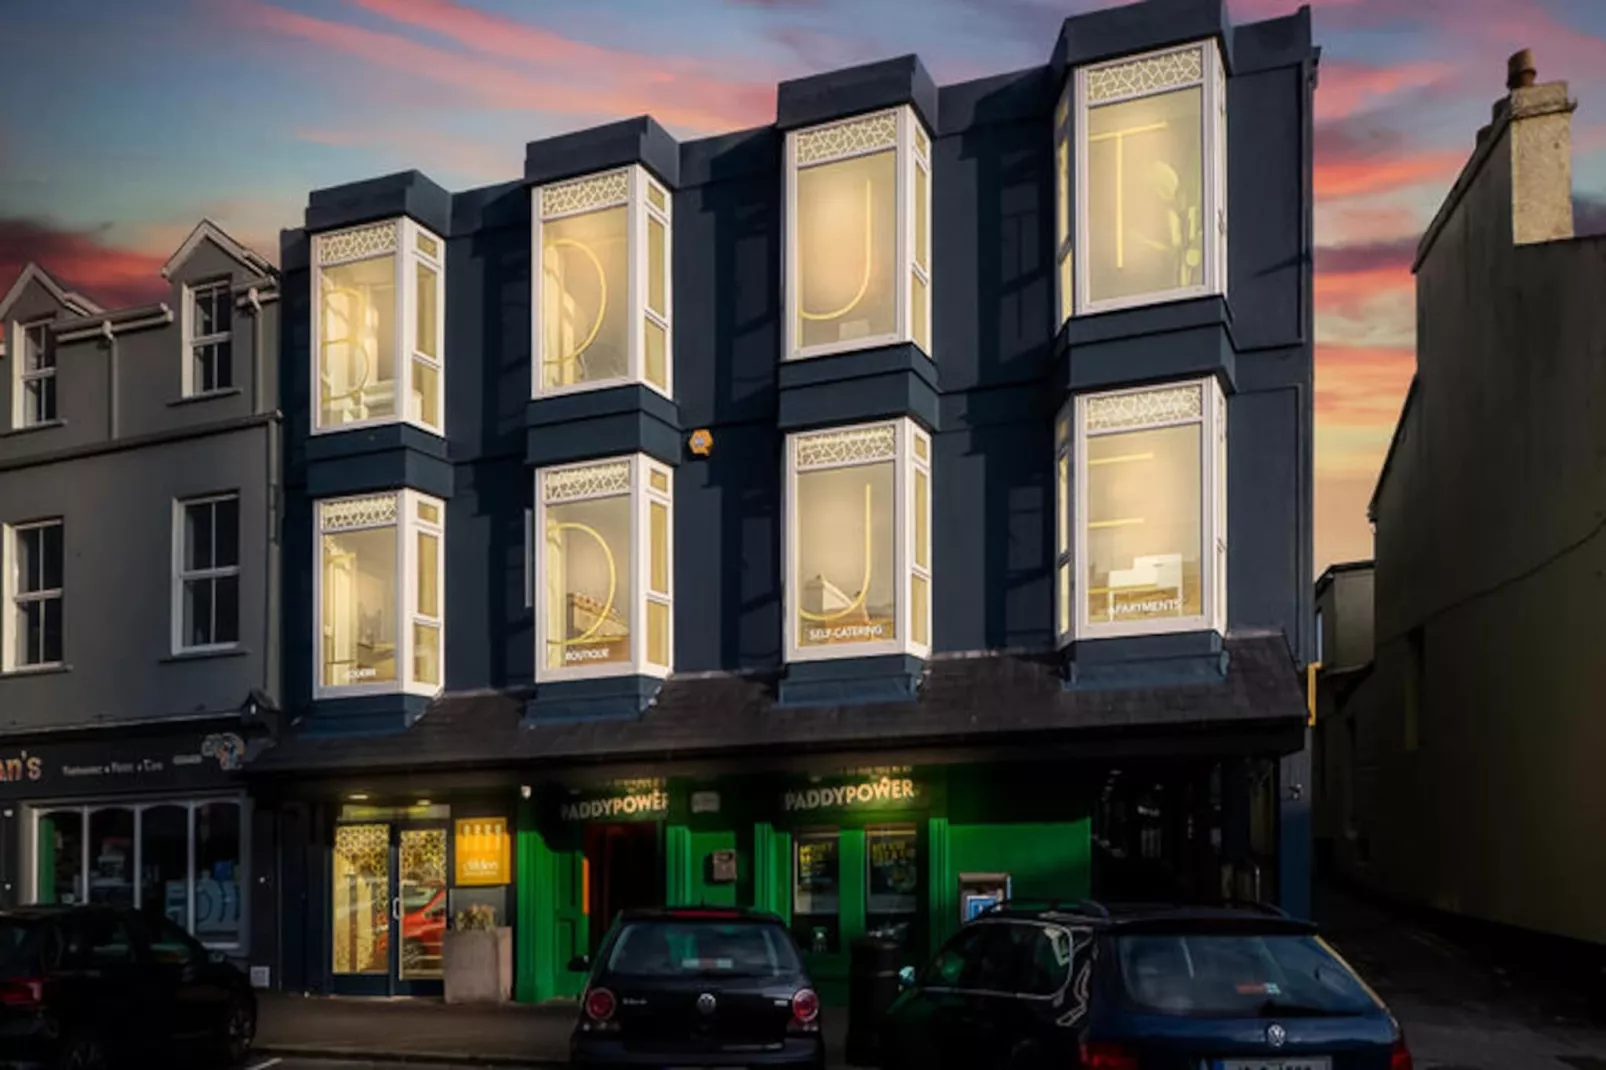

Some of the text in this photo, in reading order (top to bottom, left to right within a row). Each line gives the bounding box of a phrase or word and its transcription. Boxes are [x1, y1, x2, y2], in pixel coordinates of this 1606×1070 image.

[1108, 598, 1182, 614] APARTMENTS
[809, 624, 882, 640] SELF-CATERING
[564, 648, 610, 661] BOUTIQUE
[785, 777, 915, 811] PADDYPOWER
